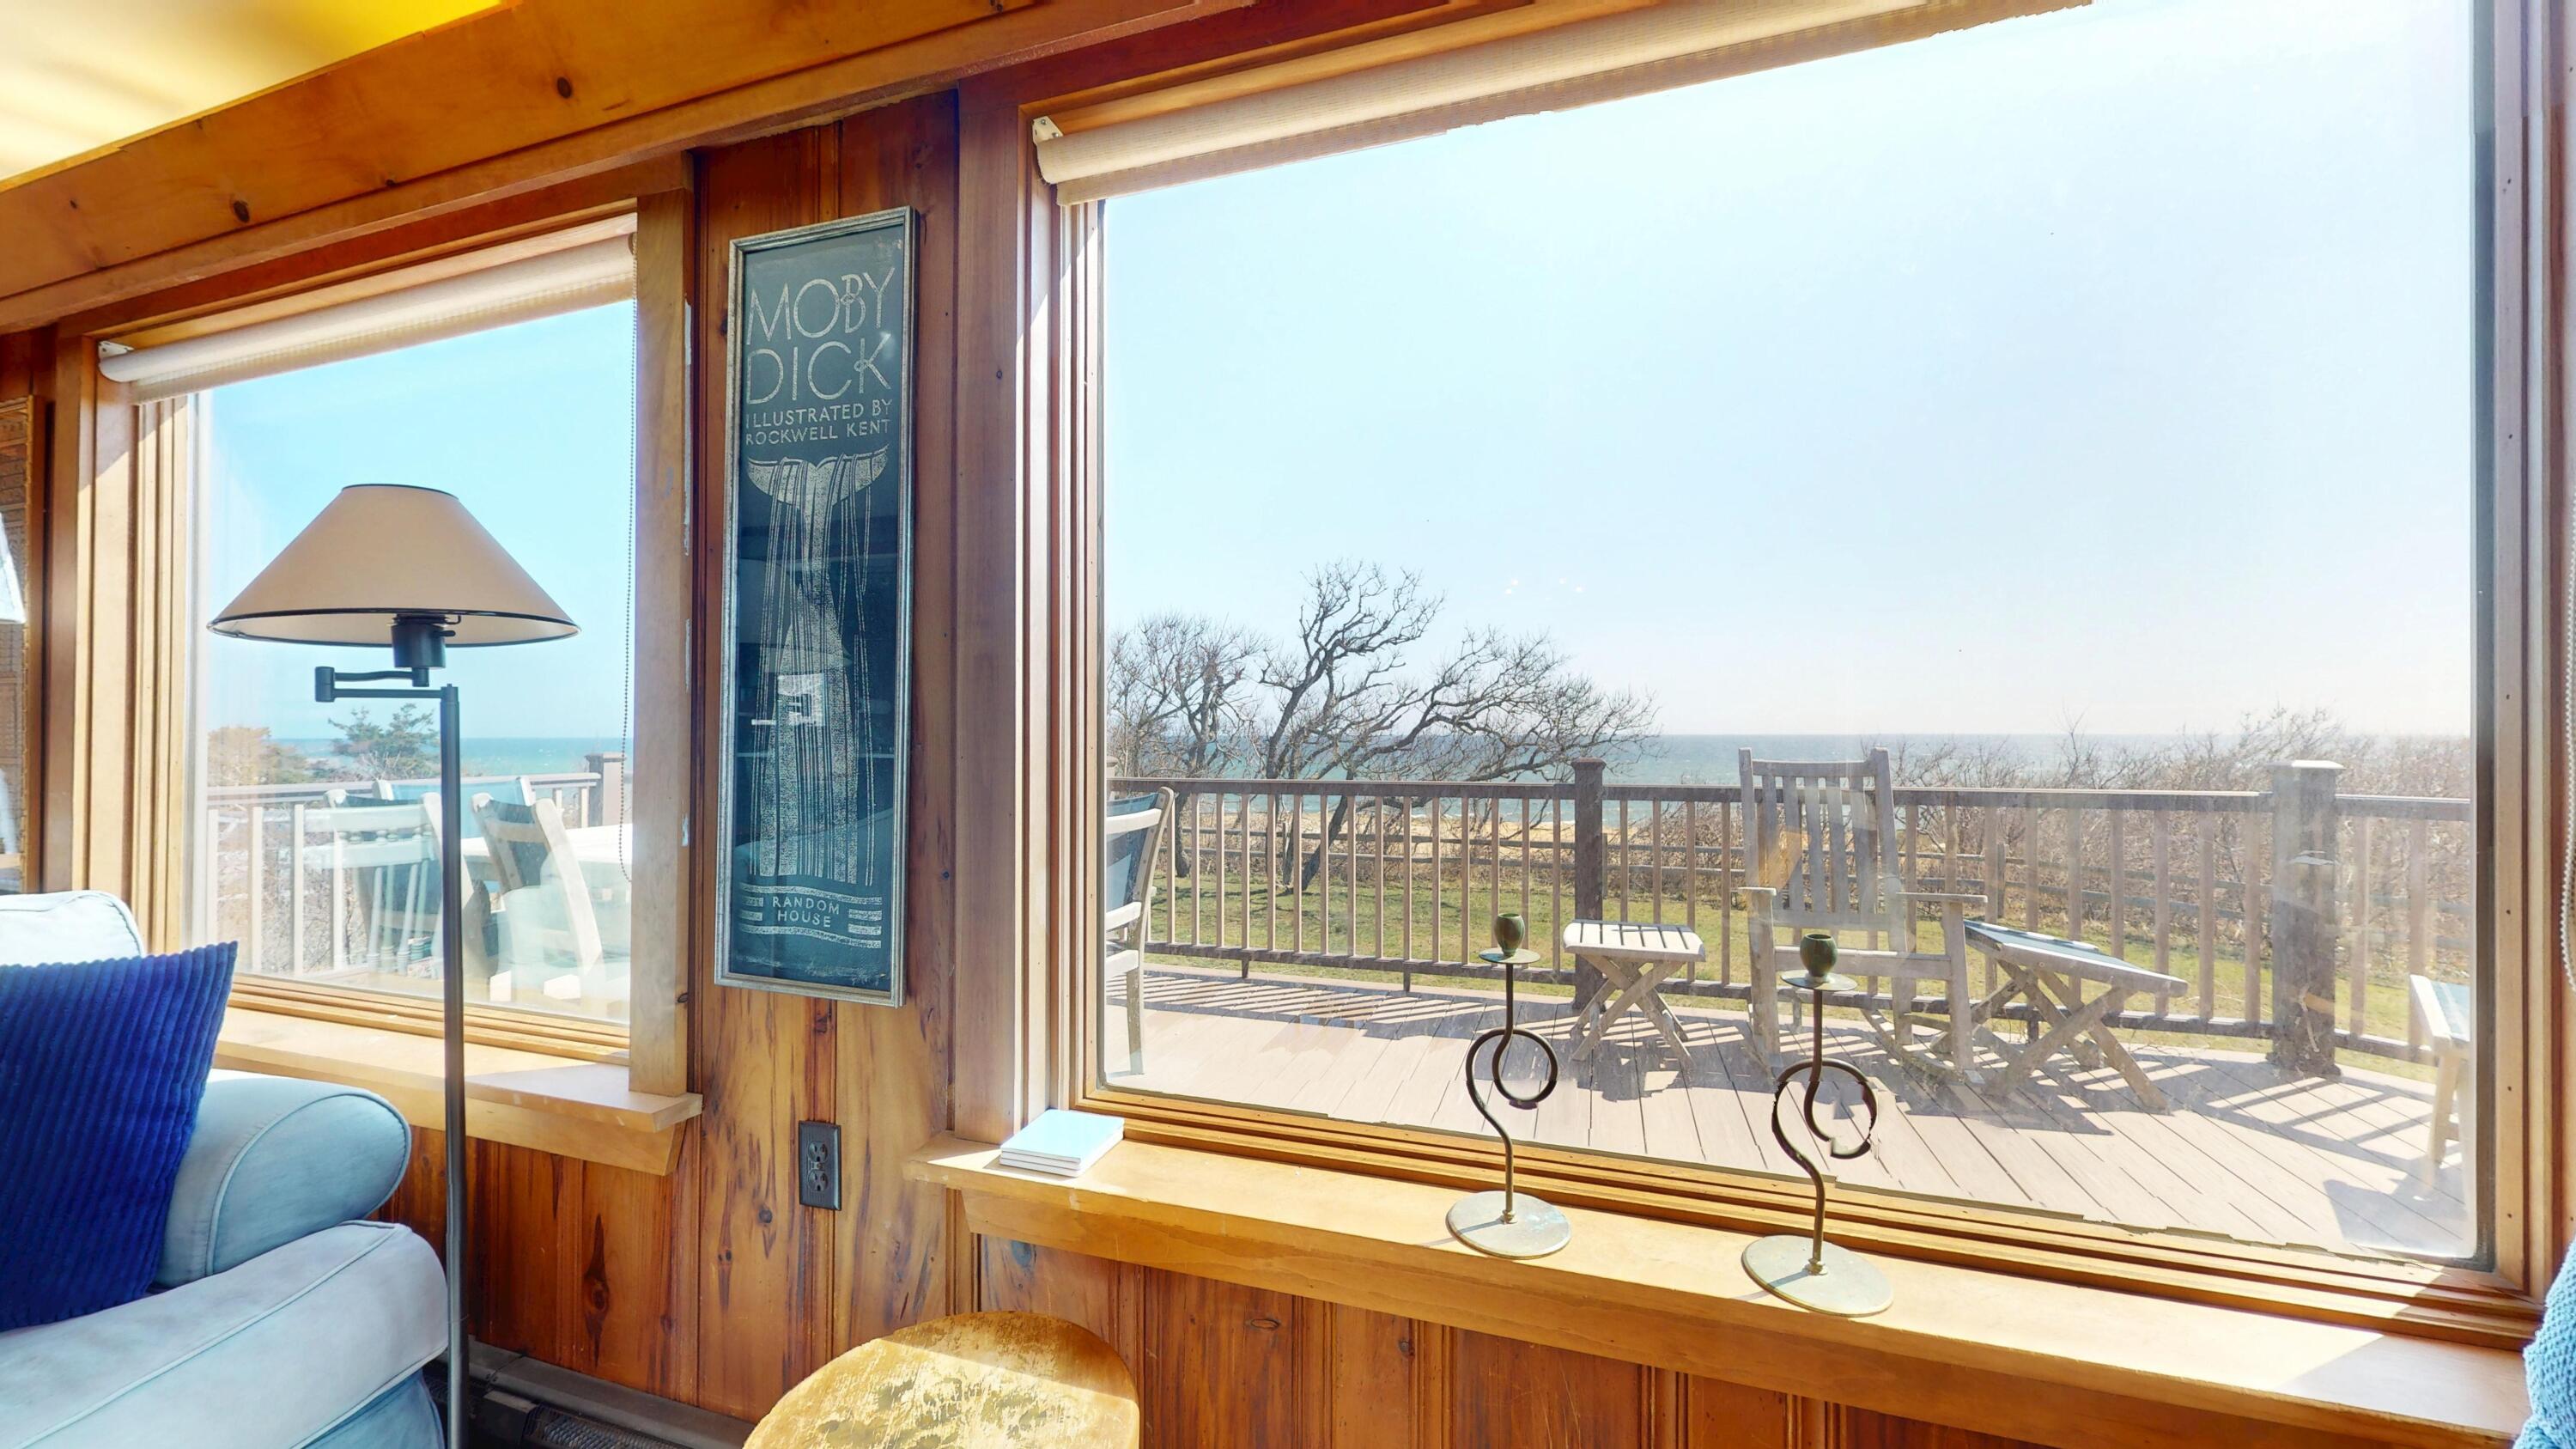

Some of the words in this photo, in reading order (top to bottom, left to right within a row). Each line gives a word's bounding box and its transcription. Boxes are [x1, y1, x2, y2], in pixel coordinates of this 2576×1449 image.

[745, 267, 895, 345] MOBY
[745, 332, 891, 405] DICK
[745, 402, 864, 429] ILLUSTRATED
[872, 399, 893, 416] BY
[745, 424, 838, 445] ROCKWELL
[846, 418, 890, 437] KENT
[772, 896, 840, 915] RANDOM
[777, 910, 831, 928] HOUSE
